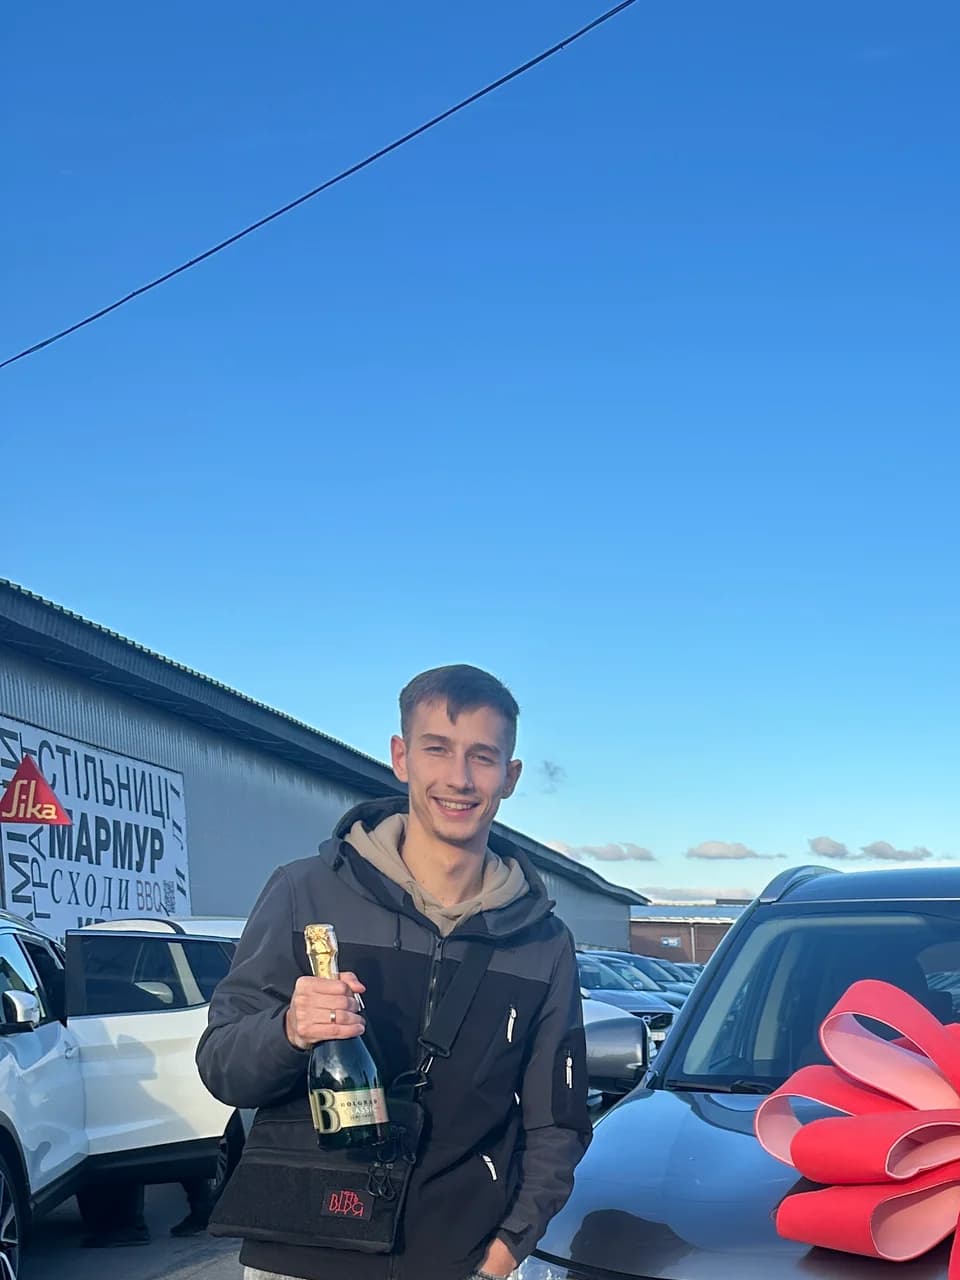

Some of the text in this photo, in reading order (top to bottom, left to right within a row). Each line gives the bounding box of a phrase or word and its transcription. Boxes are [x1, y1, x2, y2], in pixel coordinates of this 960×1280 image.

[2, 779, 58, 819] Sika
[38, 740, 170, 828] СТІЛЬНИЦІ
[50, 808, 164, 875] МАРМУР
[51, 868, 130, 917] СХОДИ
